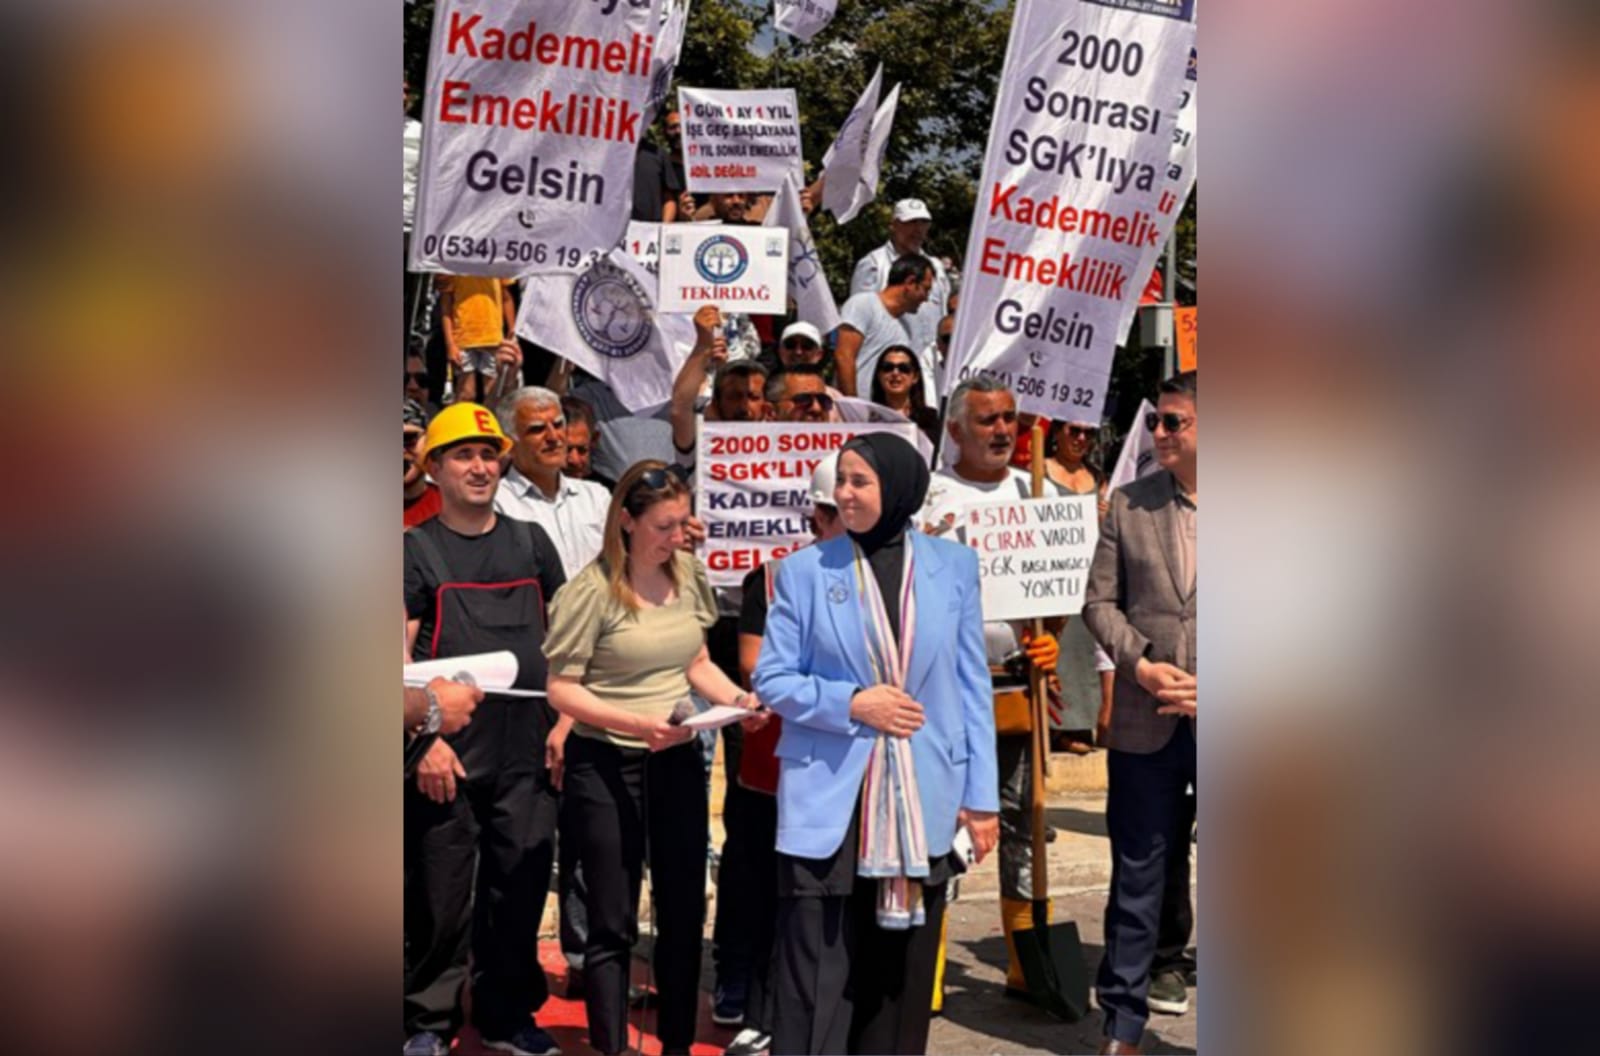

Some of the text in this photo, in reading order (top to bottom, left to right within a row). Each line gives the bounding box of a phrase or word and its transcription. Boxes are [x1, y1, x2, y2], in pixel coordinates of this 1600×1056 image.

[447, 11, 654, 77] Kademeli
[1057, 30, 1144, 77] 2000
[438, 79, 641, 144] Emeklilik
[684, 102, 792, 119] 1 GÜN 1 AY 1 YIL
[1023, 75, 1161, 135] Sonrası
[686, 121, 797, 142] İŞE GEÇ BAŞLAYANA
[700, 144, 714, 157] YIL
[716, 144, 747, 157] SONRA
[749, 143, 799, 157] EMEKLİLİK
[1005, 128, 1155, 194] SGK'lıya
[465, 149, 605, 205] Gelsin
[989, 181, 1149, 248] Kademeli
[424, 234, 498, 264] 0(534)
[505, 240, 548, 264] 506
[556, 246, 581, 268] 19
[632, 240, 641, 256] 1
[979, 237, 1128, 301] Emeklilik
[680, 284, 770, 301] TEKİRDAĞ
[993, 298, 1095, 351] Gelsin
[1016, 375, 1046, 398] 506
[1051, 381, 1070, 402] 19
[1073, 387, 1095, 407] 32
[474, 410, 494, 433] E
[710, 435, 770, 455] 2000
[1034, 502, 1083, 522] VARDI
[1041, 527, 1086, 547] VARDI
[1020, 577, 1080, 599] YOKTU
